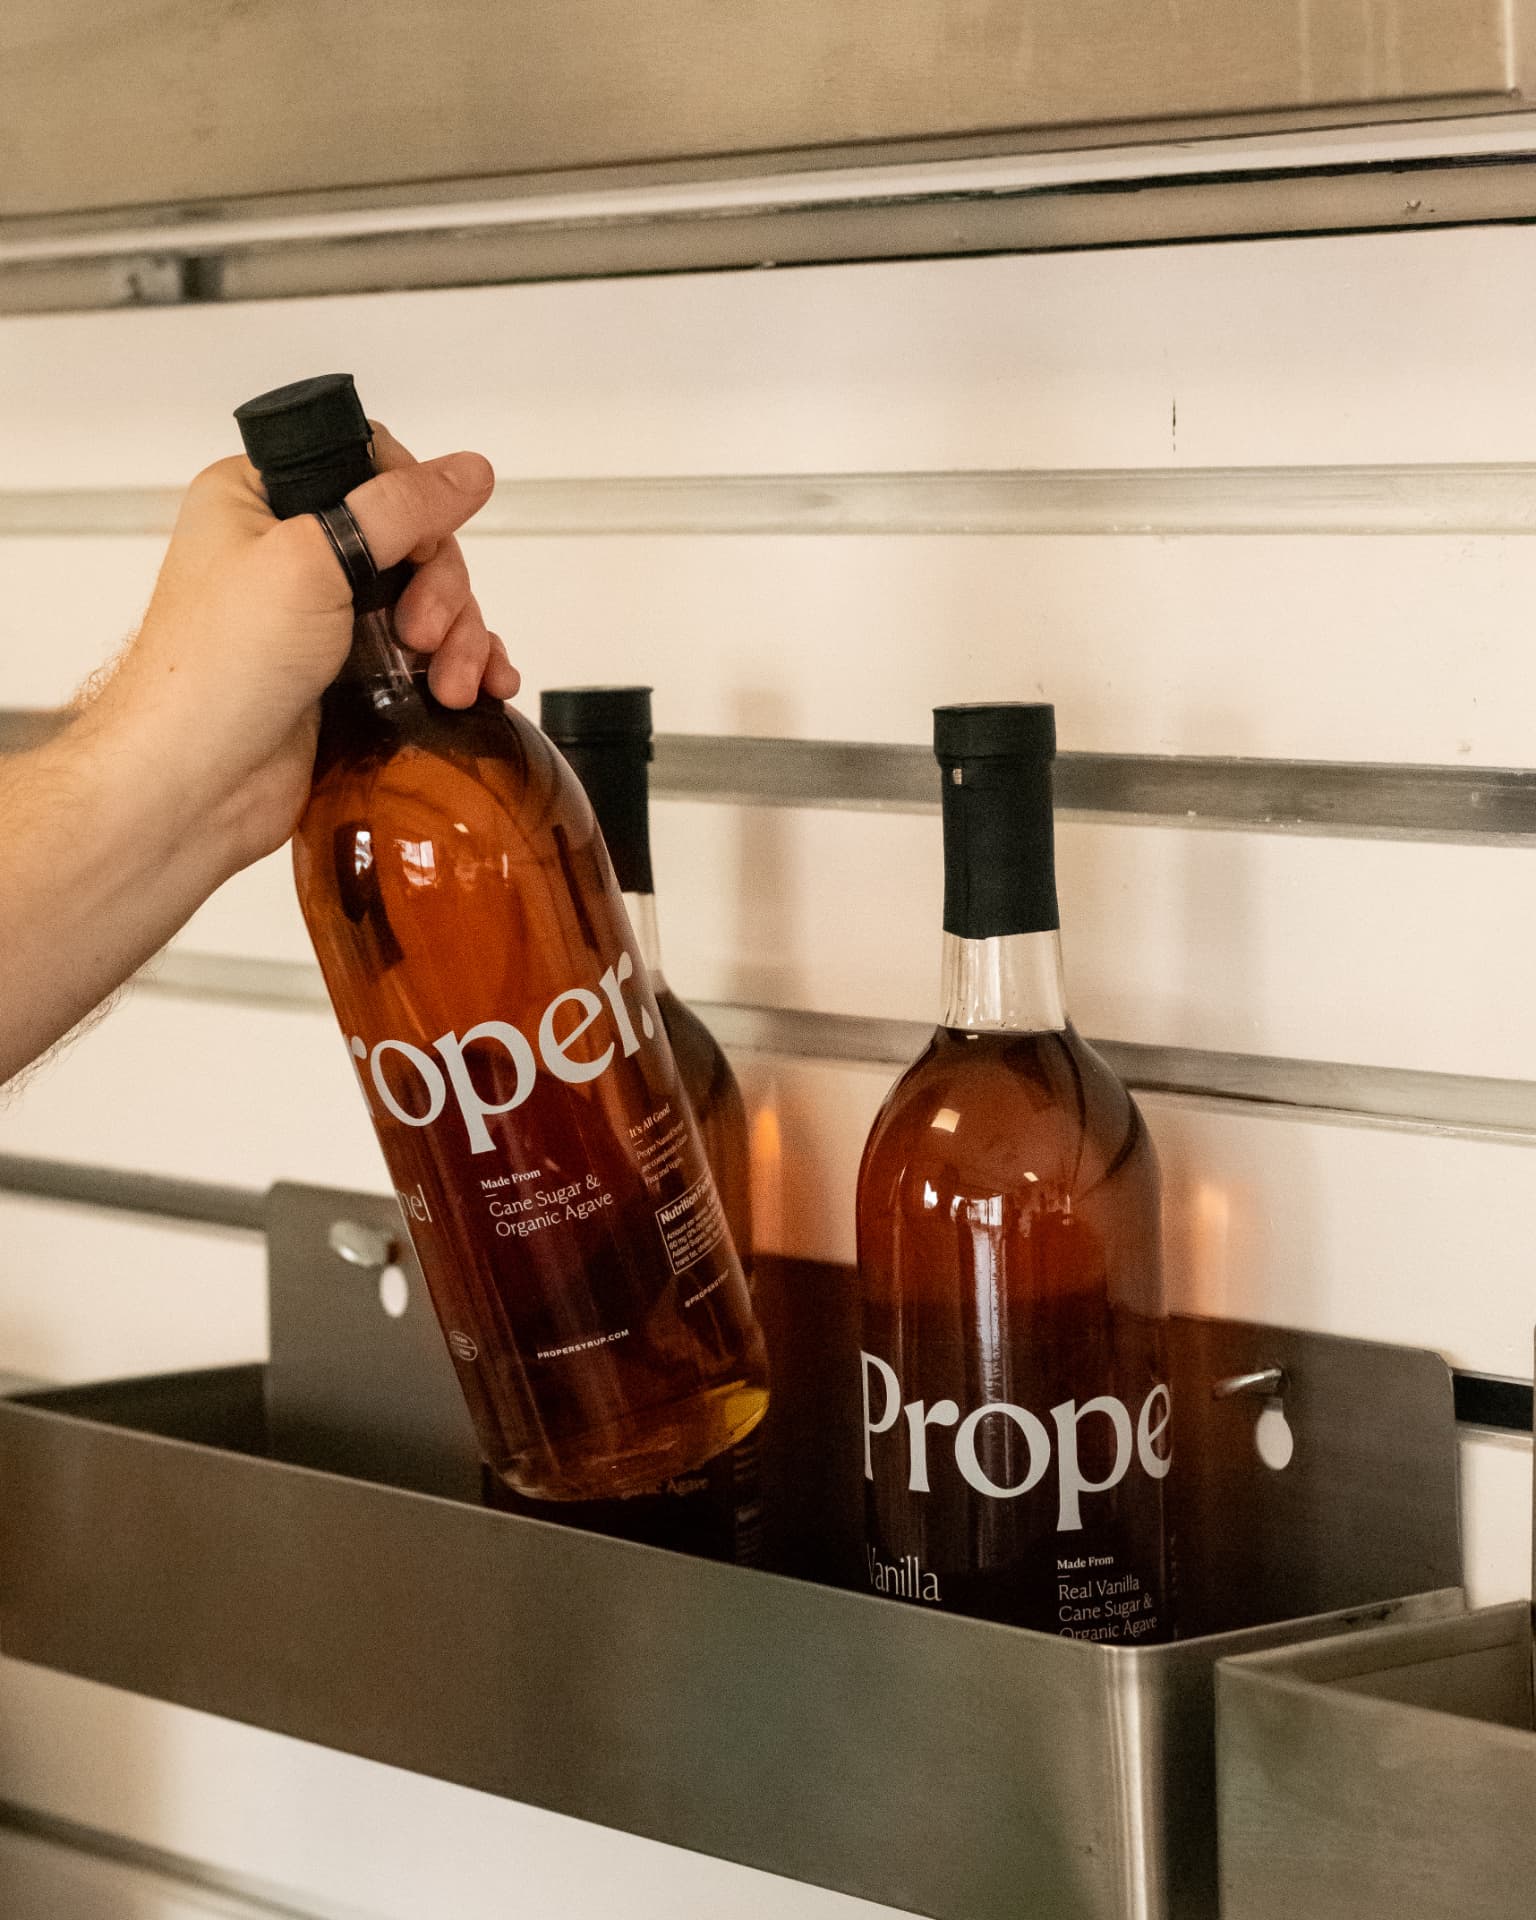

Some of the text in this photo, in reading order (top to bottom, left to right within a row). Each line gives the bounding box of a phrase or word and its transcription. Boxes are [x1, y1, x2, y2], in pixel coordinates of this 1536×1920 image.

[629, 1125, 642, 1139] It's
[643, 1116, 654, 1131] All
[652, 1101, 671, 1122] Good
[480, 1169, 542, 1190] Made From
[489, 1173, 600, 1217] Cane Sugar &
[495, 1193, 613, 1237] Organic Agave
[660, 1192, 699, 1224] Nutrition
[537, 1328, 630, 1360] PROPERSYRUP.COM
[866, 1543, 942, 1602] Vanilla
[1057, 1556, 1114, 1570] Made From
[1058, 1574, 1140, 1600] Real Vanilla
[1058, 1592, 1153, 1622] Cane Sugar &
[1060, 1616, 1158, 1640] Organic Agave
